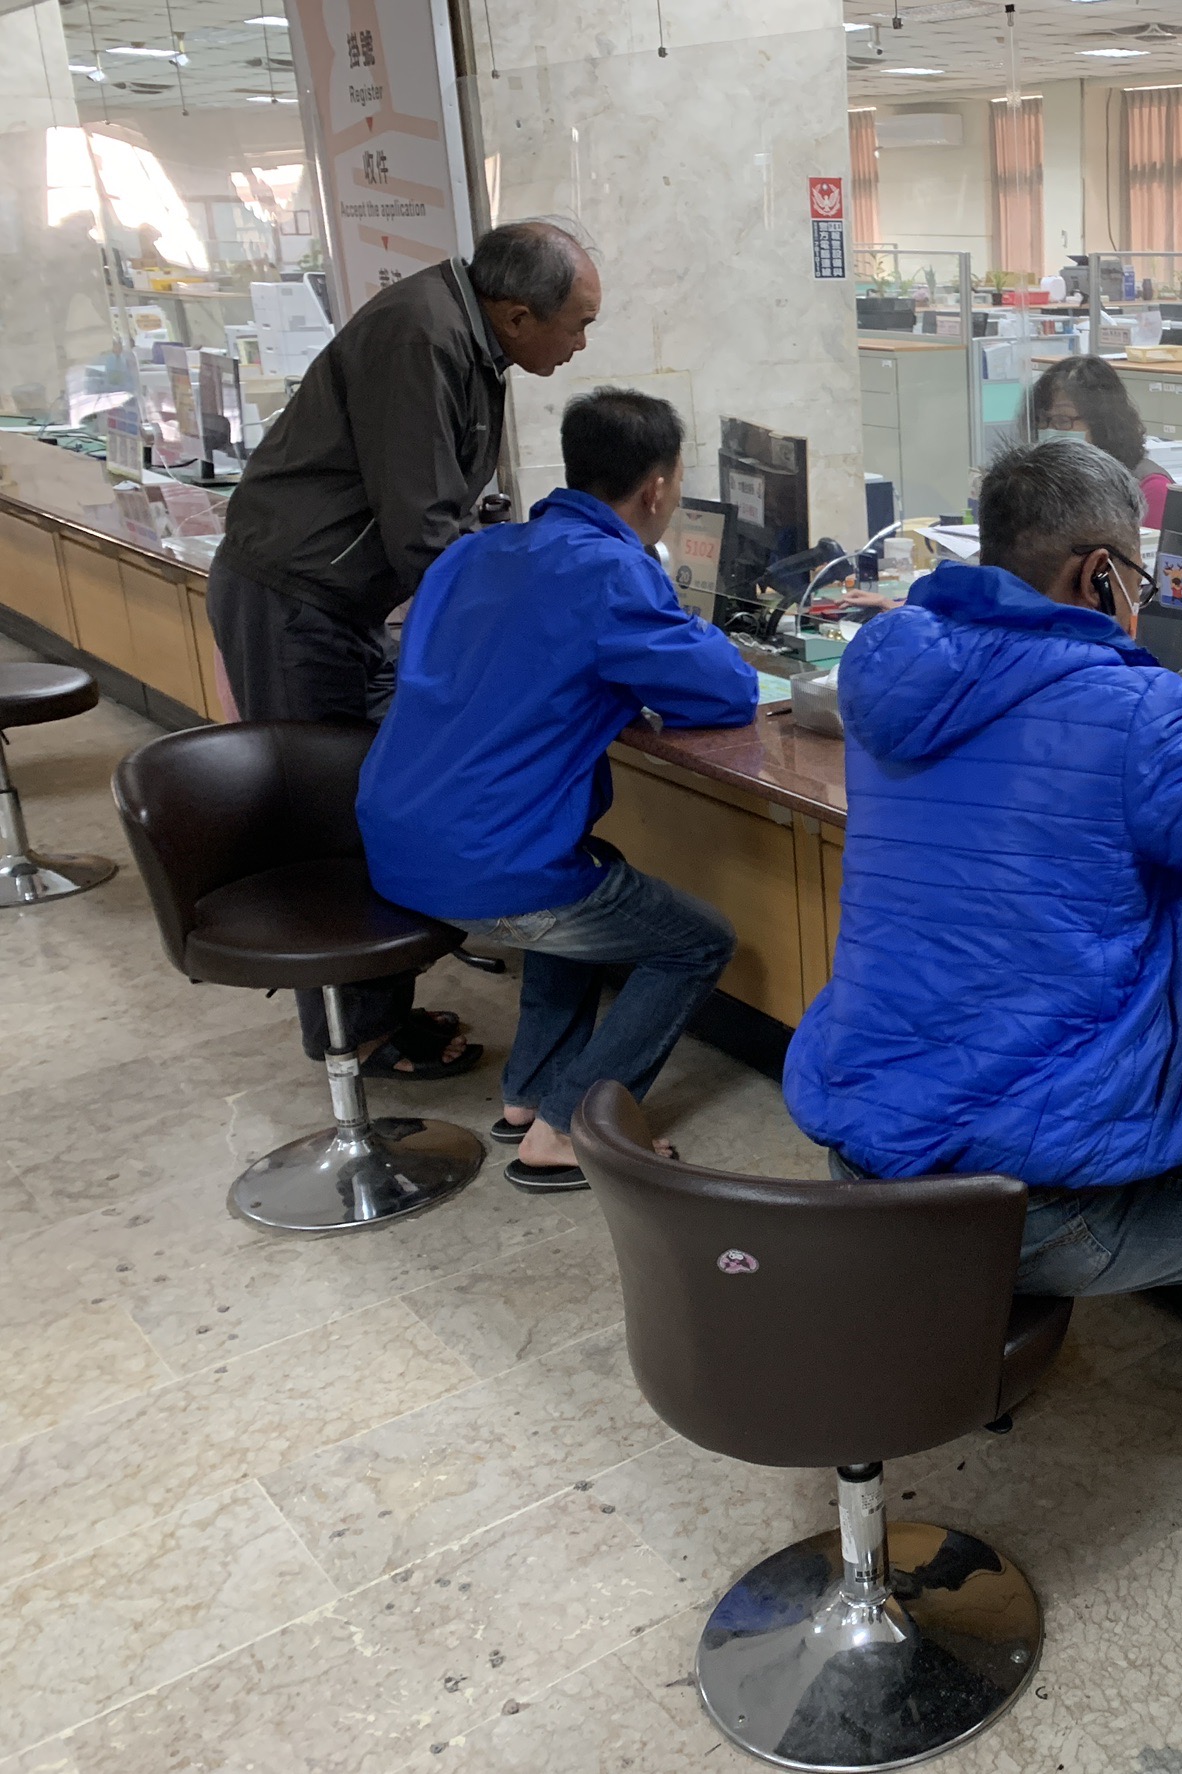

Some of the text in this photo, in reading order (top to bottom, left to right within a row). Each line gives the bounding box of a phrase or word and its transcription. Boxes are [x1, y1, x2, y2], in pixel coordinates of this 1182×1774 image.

[349, 84, 383, 106] Register
[363, 150, 389, 184] 收件
[340, 199, 426, 221] Accept the application
[685, 539, 713, 558] 5102
